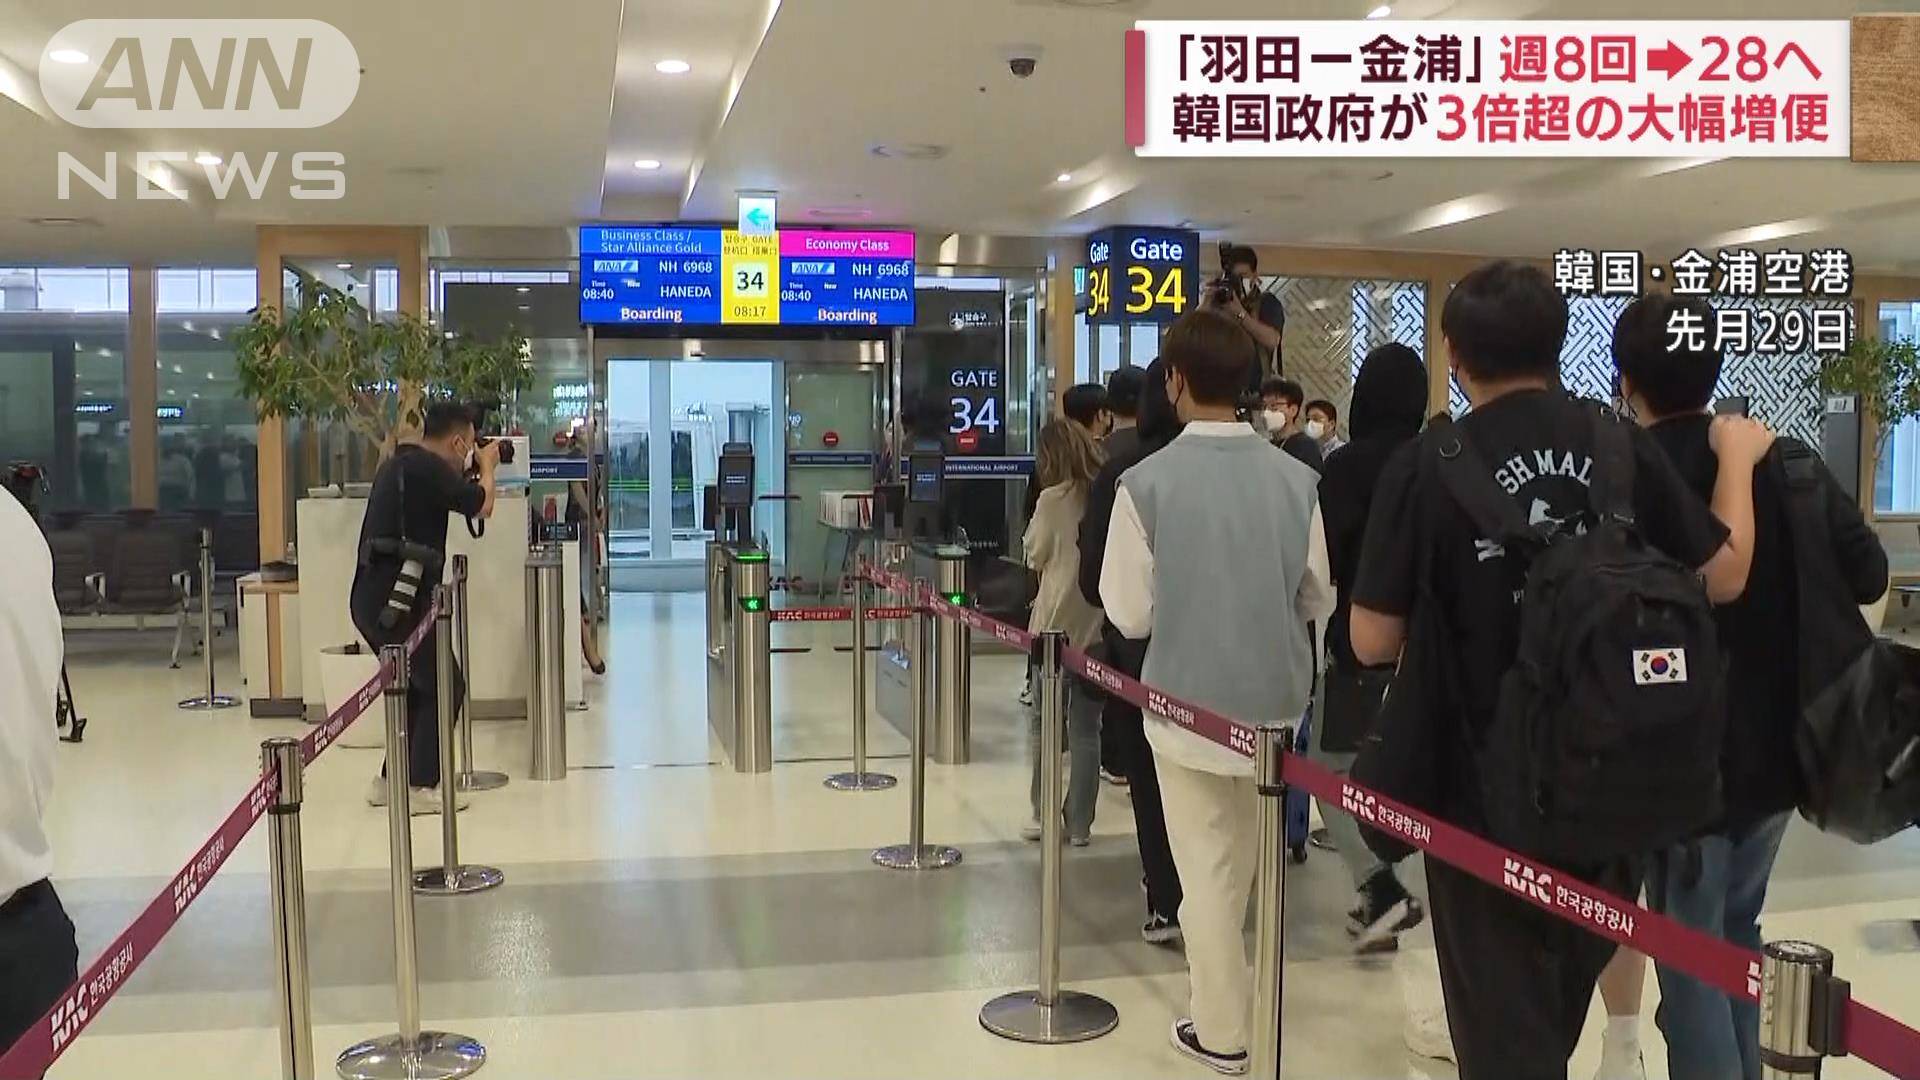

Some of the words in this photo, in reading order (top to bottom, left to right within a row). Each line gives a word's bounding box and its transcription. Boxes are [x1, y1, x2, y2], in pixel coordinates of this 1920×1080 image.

[601, 229, 652, 241] Business
[654, 229, 684, 241] Class
[601, 242, 623, 254] Star
[626, 242, 673, 254] Alliance
[675, 242, 703, 254] Gold
[805, 237, 858, 252] Economy
[860, 238, 890, 252] Class
[1090, 241, 1109, 264] Gate
[1130, 238, 1183, 261] Gate
[598, 261, 622, 272] ANA
[659, 261, 677, 273] NH
[683, 261, 713, 273] 6968
[795, 263, 819, 274] ANA
[852, 263, 872, 275] NH
[878, 263, 909, 276] 6968
[736, 271, 764, 291] 34
[583, 288, 615, 300] 08:40
[660, 286, 712, 298] HANEDA
[781, 290, 811, 301] 08:40
[853, 288, 908, 301] HANEDA
[1088, 267, 1110, 316] 34
[1126, 265, 1187, 314] 34
[621, 307, 683, 322] Boarding
[734, 306, 767, 317] 08:17
[818, 308, 878, 324] Boarding
[951, 370, 998, 388] GATE
[949, 397, 1000, 434] 34
[1148, 690, 1167, 716] KAC
[1230, 725, 1256, 754] KAC
[1341, 783, 1376, 821] KAC
[1377, 803, 1431, 844] 한국공항공사
[174, 863, 197, 915] KAC
[1503, 857, 1553, 905] KAC
[1555, 884, 1635, 938] 한국공항공사
[50, 983, 89, 1052] KAC
[90, 941, 133, 1007] 한국공항공사
